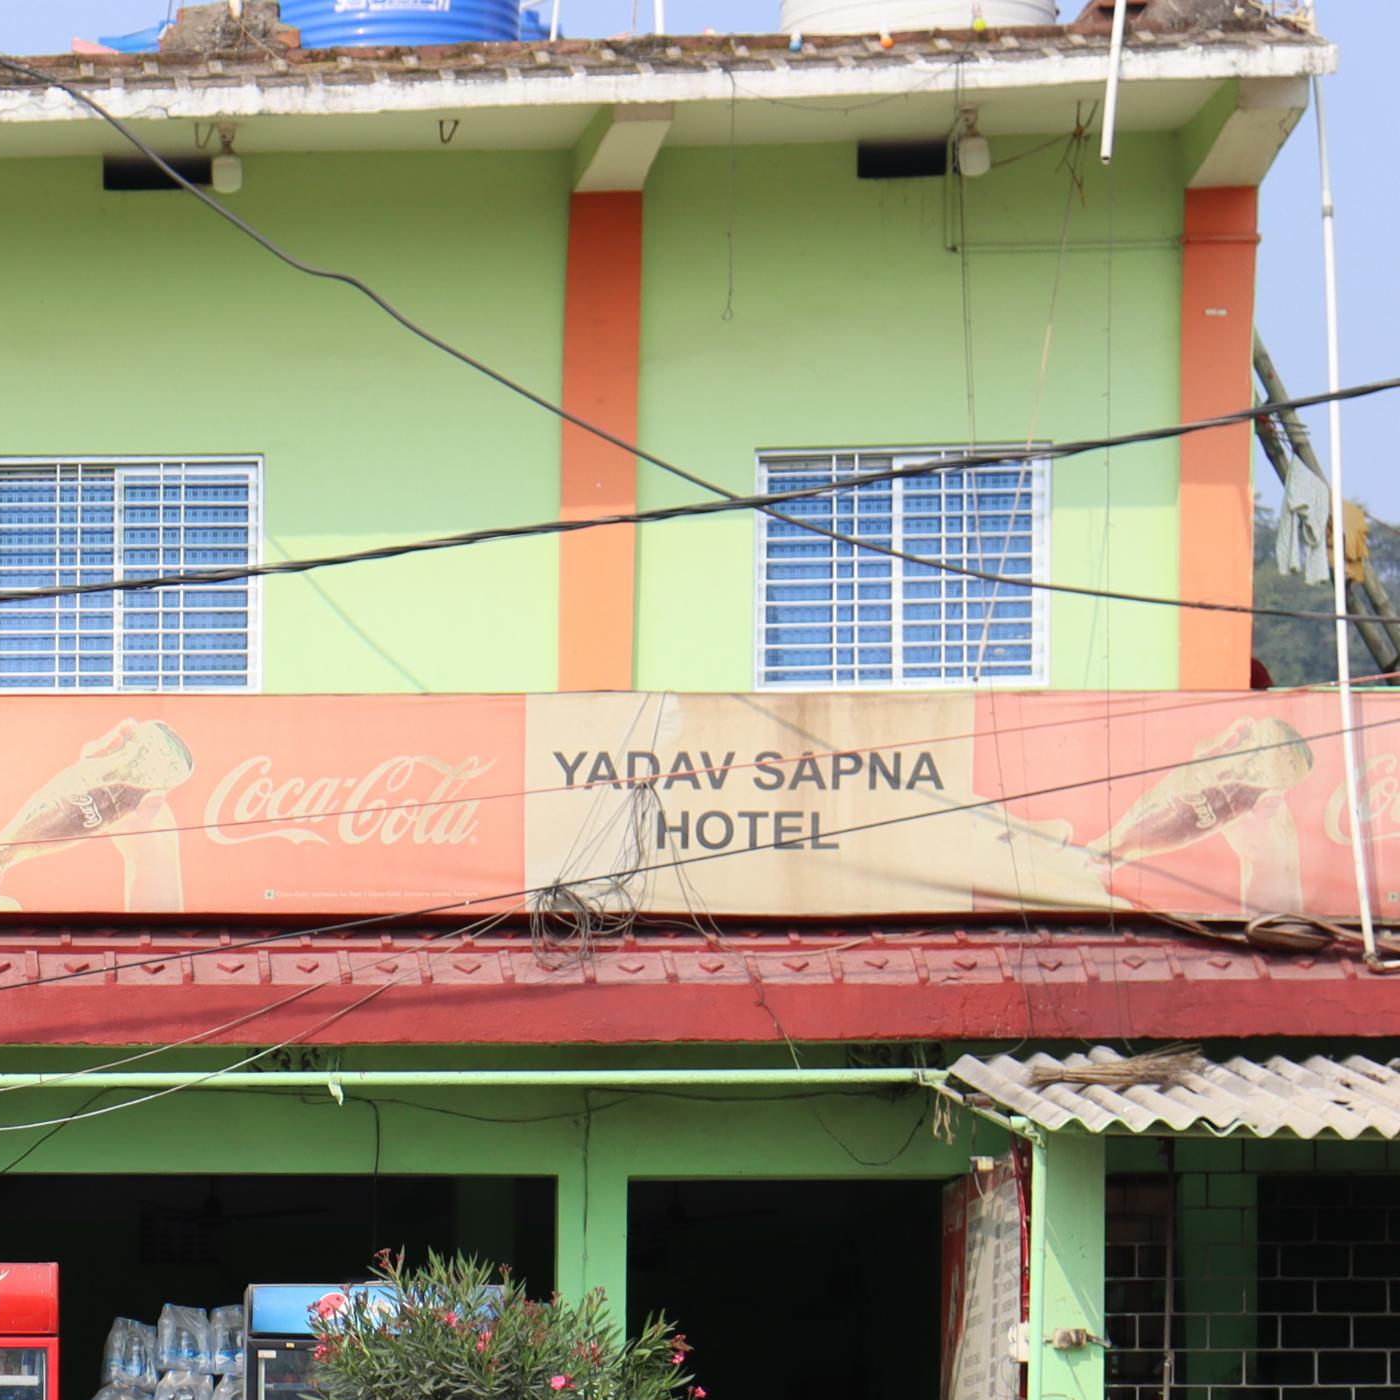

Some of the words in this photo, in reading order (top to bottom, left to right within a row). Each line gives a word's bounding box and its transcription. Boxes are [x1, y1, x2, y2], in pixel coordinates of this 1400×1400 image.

[553, 750, 736, 791] YADAV
[752, 750, 945, 791] SAPNA
[202, 754, 499, 846] Coca-Cola
[655, 810, 840, 850] HOTEL
